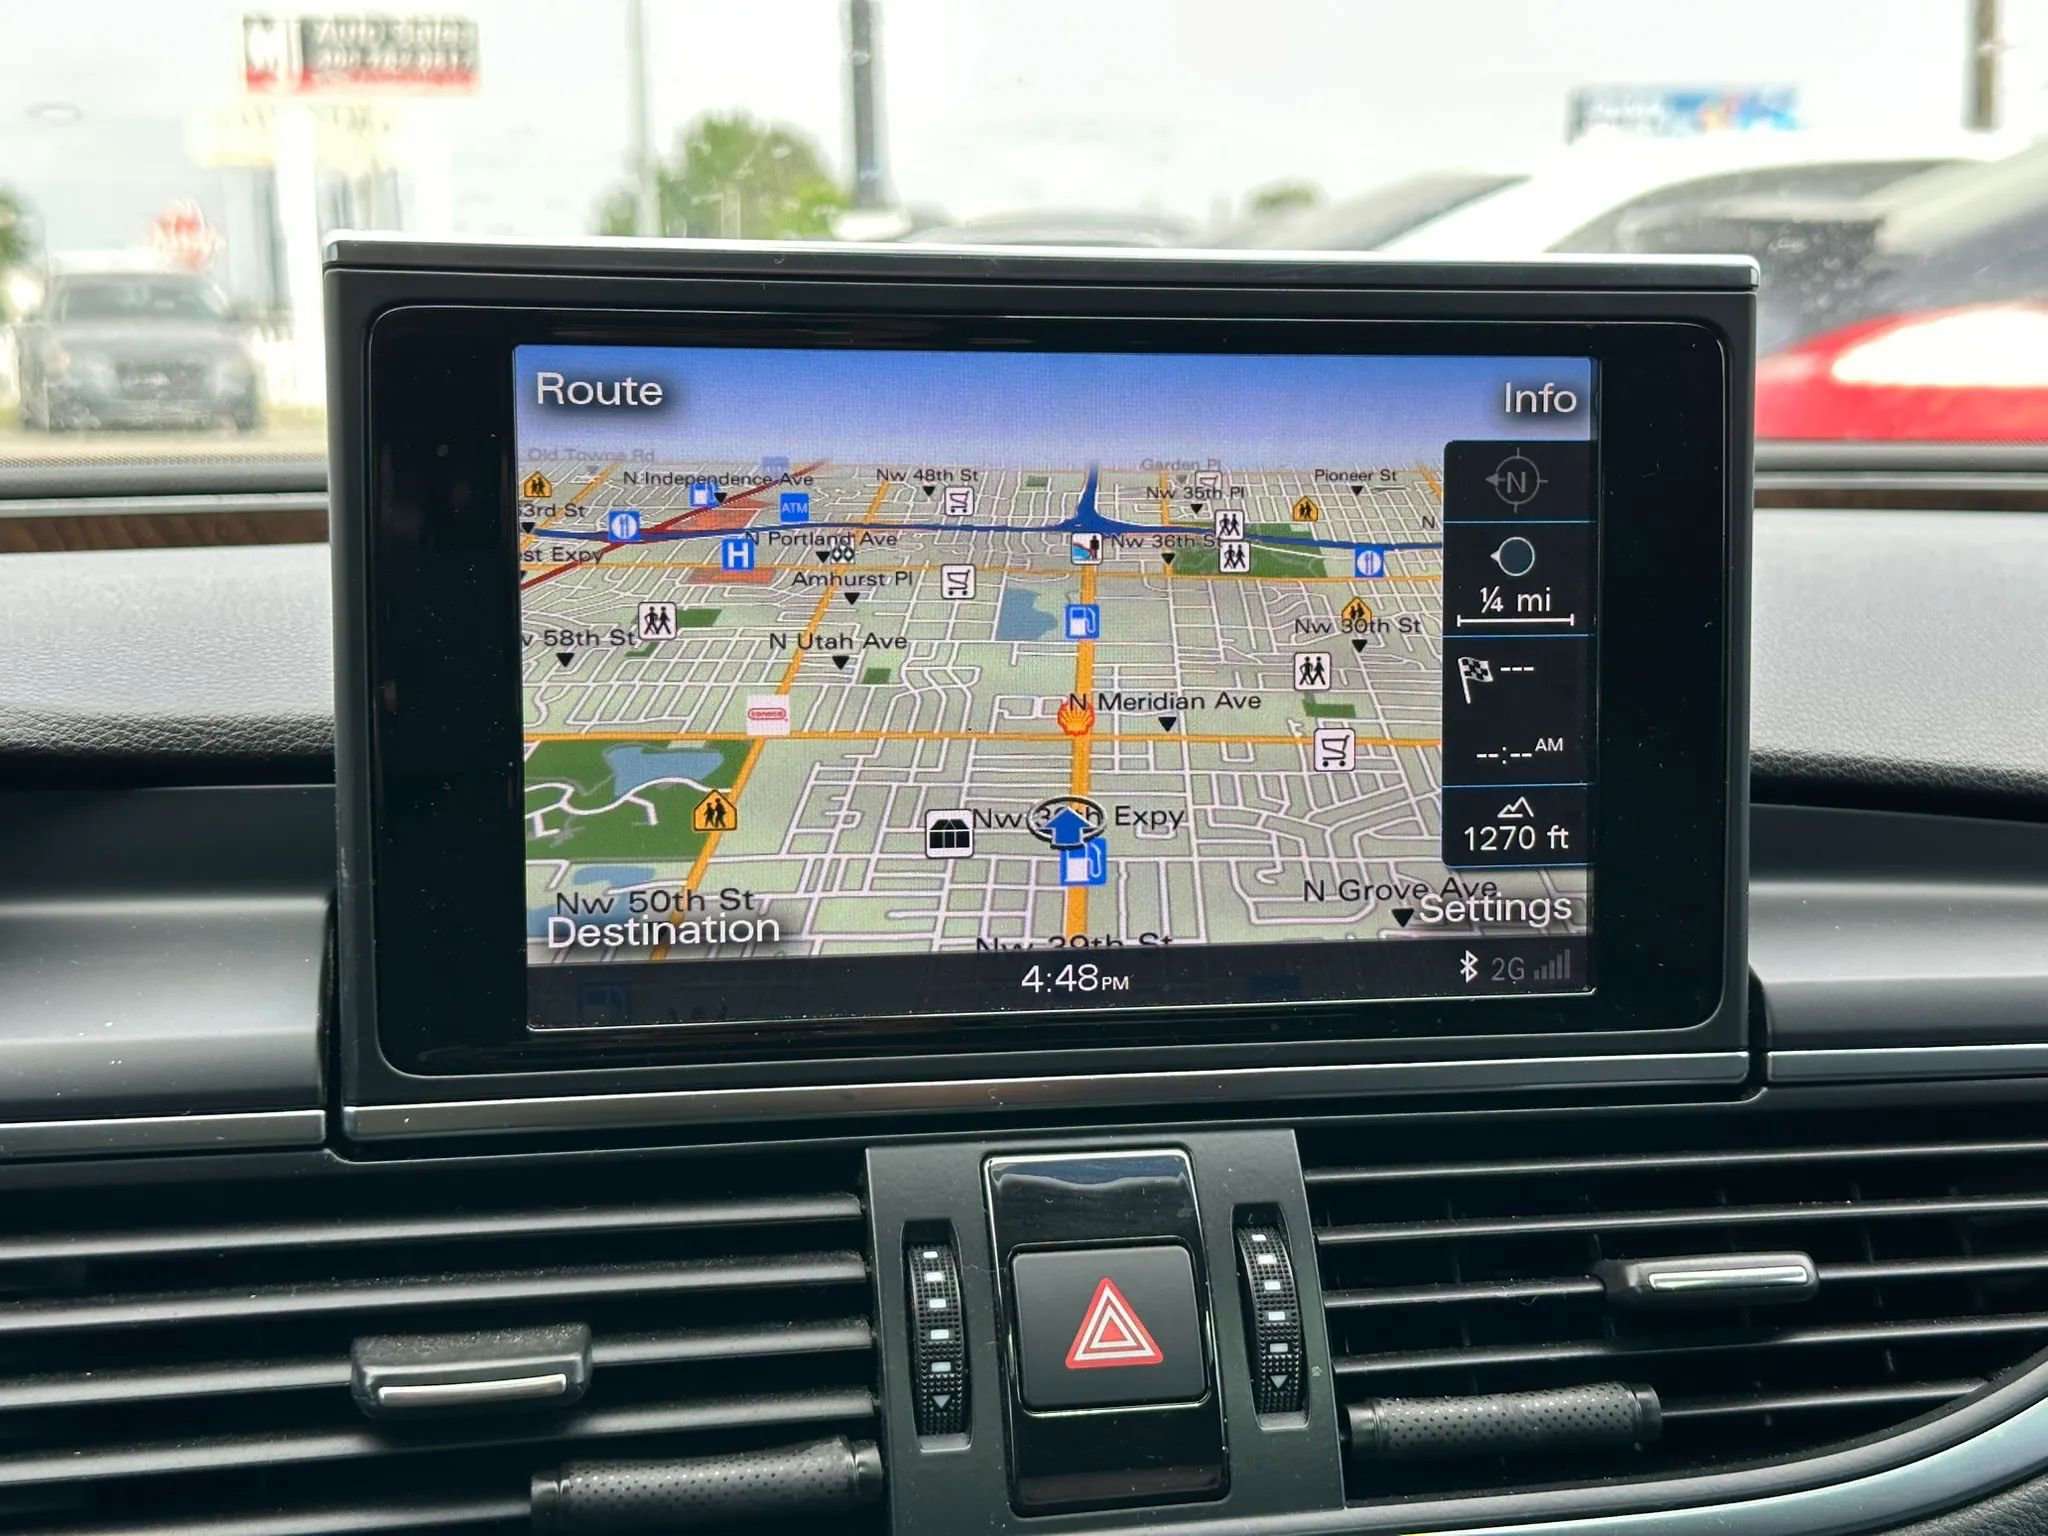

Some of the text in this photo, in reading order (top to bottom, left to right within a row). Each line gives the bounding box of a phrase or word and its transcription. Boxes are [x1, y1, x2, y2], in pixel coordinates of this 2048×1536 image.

[537, 371, 663, 407] Route
[1505, 382, 1577, 413] Info
[1141, 458, 1199, 471] Garden
[623, 471, 814, 489] N Independence Ave
[877, 468, 979, 482] Nw 48th St
[1315, 469, 1397, 482] Pioneer St
[1507, 472, 1526, 493] N
[1147, 486, 1245, 499] Nw 35th Pl
[565, 502, 586, 517] St
[782, 502, 808, 514] ATM
[1421, 516, 1436, 529] N
[746, 531, 898, 546] N Portland Ave
[1111, 534, 1223, 548] Nw 36th St
[553, 547, 604, 565] Expy
[728, 542, 750, 568] H
[792, 571, 912, 587] Amhurst Pl
[1517, 587, 1551, 612] mi
[1294, 618, 1421, 634] Nw 30th St
[543, 629, 600, 646] 58th
[610, 628, 636, 646] St
[769, 632, 908, 650] N Utah Ave
[1069, 691, 1262, 711] N Meridian Ave
[1535, 738, 1564, 752] AM
[973, 809, 1022, 828] Nw
[1115, 806, 1185, 832] Expy
[1464, 824, 1569, 851] 1270 ft
[1303, 876, 1498, 901] N Grove Ave
[556, 887, 754, 916] Nw 50th St
[1419, 891, 1573, 928] Settings
[548, 912, 780, 949] Destination
[1491, 957, 1525, 982] 2G
